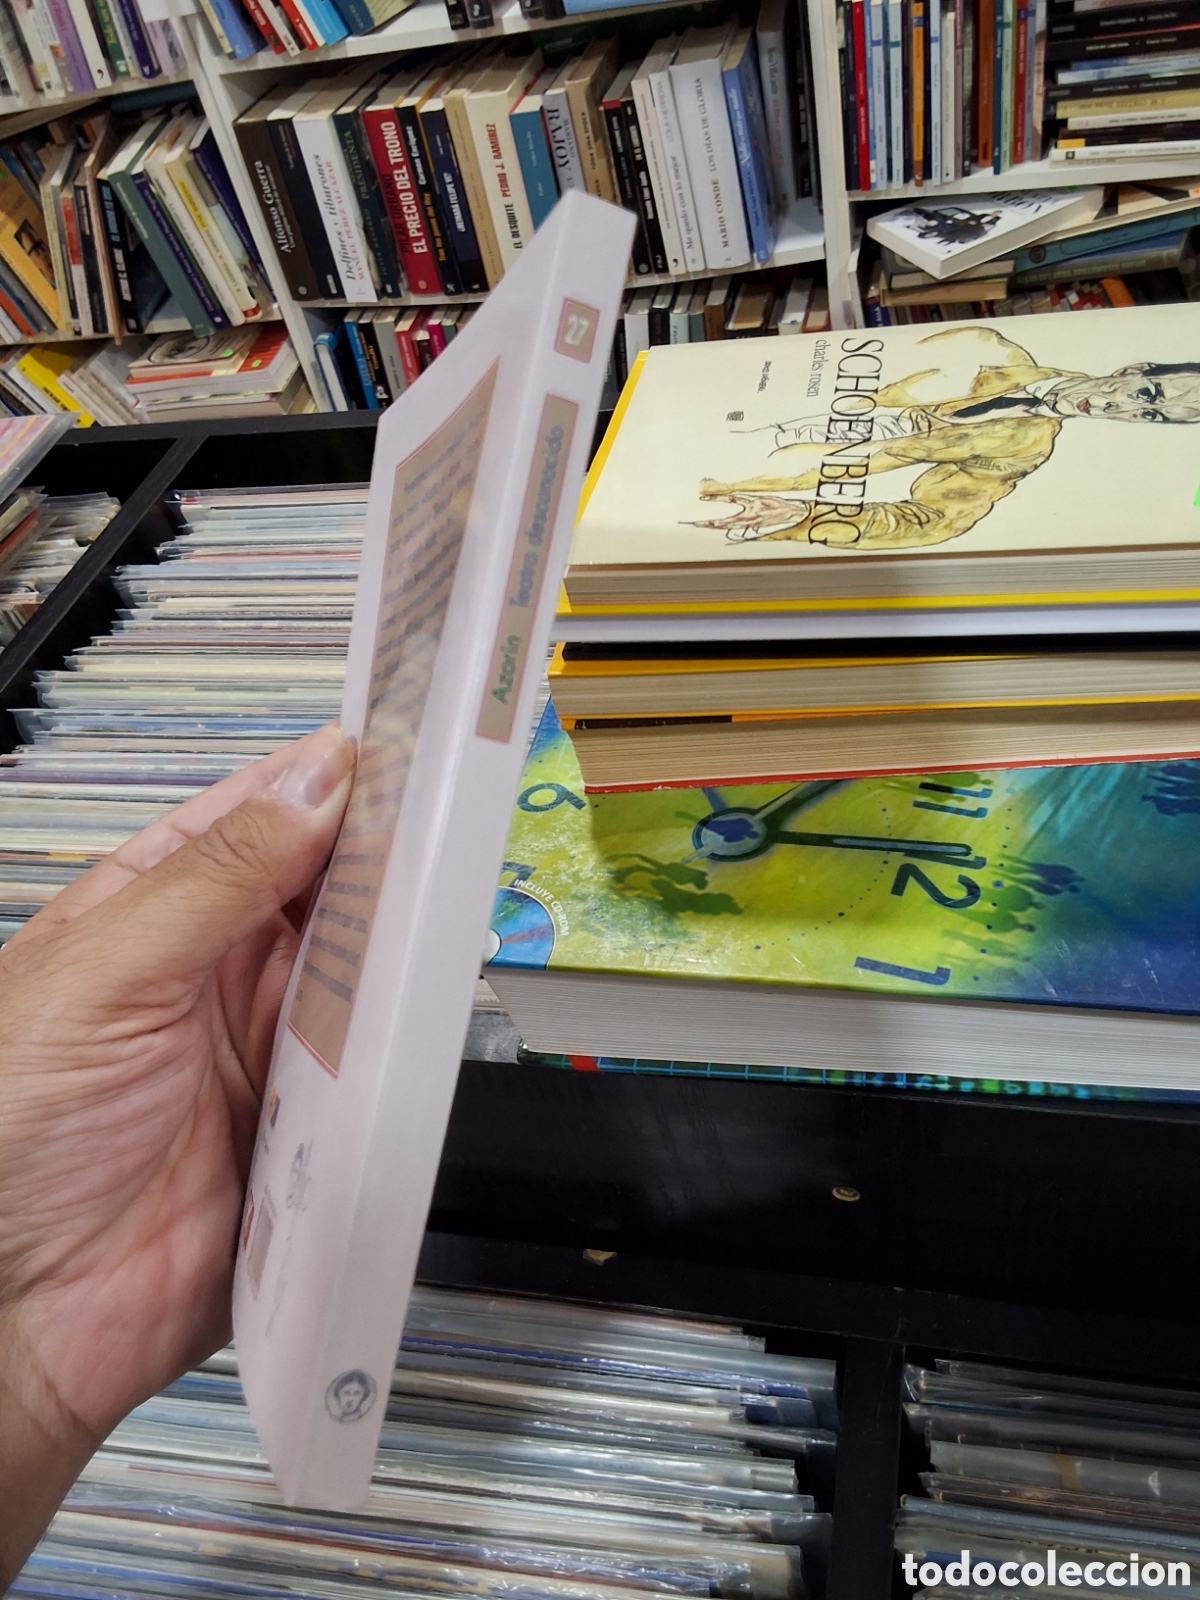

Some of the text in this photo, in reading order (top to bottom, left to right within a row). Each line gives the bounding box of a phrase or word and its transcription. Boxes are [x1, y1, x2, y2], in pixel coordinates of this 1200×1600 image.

[486, 123, 502, 160] RAMÍREZ
[541, 108, 573, 169] RAJOY
[694, 77, 716, 172] LOS DÍAS DE GLORIA
[313, 154, 335, 216] tiburones
[344, 130, 368, 199] PRESIDENTA
[381, 121, 427, 254] EL PRECIO DEL TRONO
[414, 158, 426, 184] Carmen
[446, 183, 457, 203] FELIPE
[497, 172, 511, 197] PEDRO
[254, 160, 290, 253] Alfonso Guerra
[382, 172, 411, 254] PILAR URBANO
[504, 203, 520, 238] DESQUITE
[670, 155, 693, 248] Me quedo con lo mejor
[711, 179, 728, 247] MARIO CONDE
[336, 230, 355, 280] Delfines
[806, 339, 831, 398] charles rosen
[808, 337, 884, 546] SCHOENBERG
[513, 878, 570, 937] INCLUYE CD-ROM
[854, 956, 952, 987] 1
